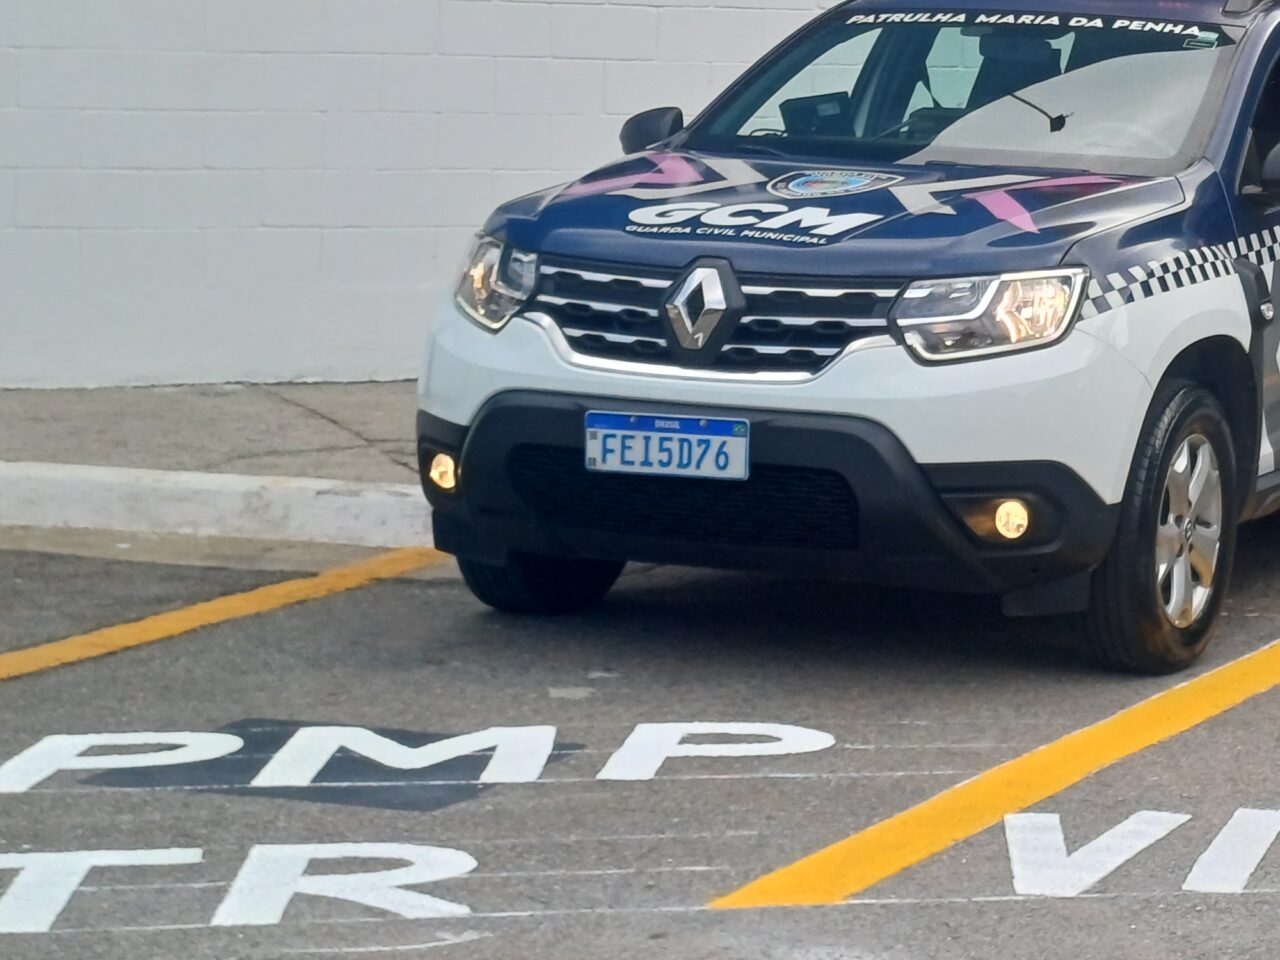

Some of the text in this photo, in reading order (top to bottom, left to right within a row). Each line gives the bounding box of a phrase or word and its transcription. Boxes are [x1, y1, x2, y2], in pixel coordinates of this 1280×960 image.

[845, 13, 1201, 37] PATRULHA MARIA DA PENHA
[625, 225, 827, 245] GUARDA CIVIL MUNICIPAL
[628, 201, 884, 236] GCM
[601, 433, 730, 471] FEI5D76
[0, 722, 836, 792] PMP
